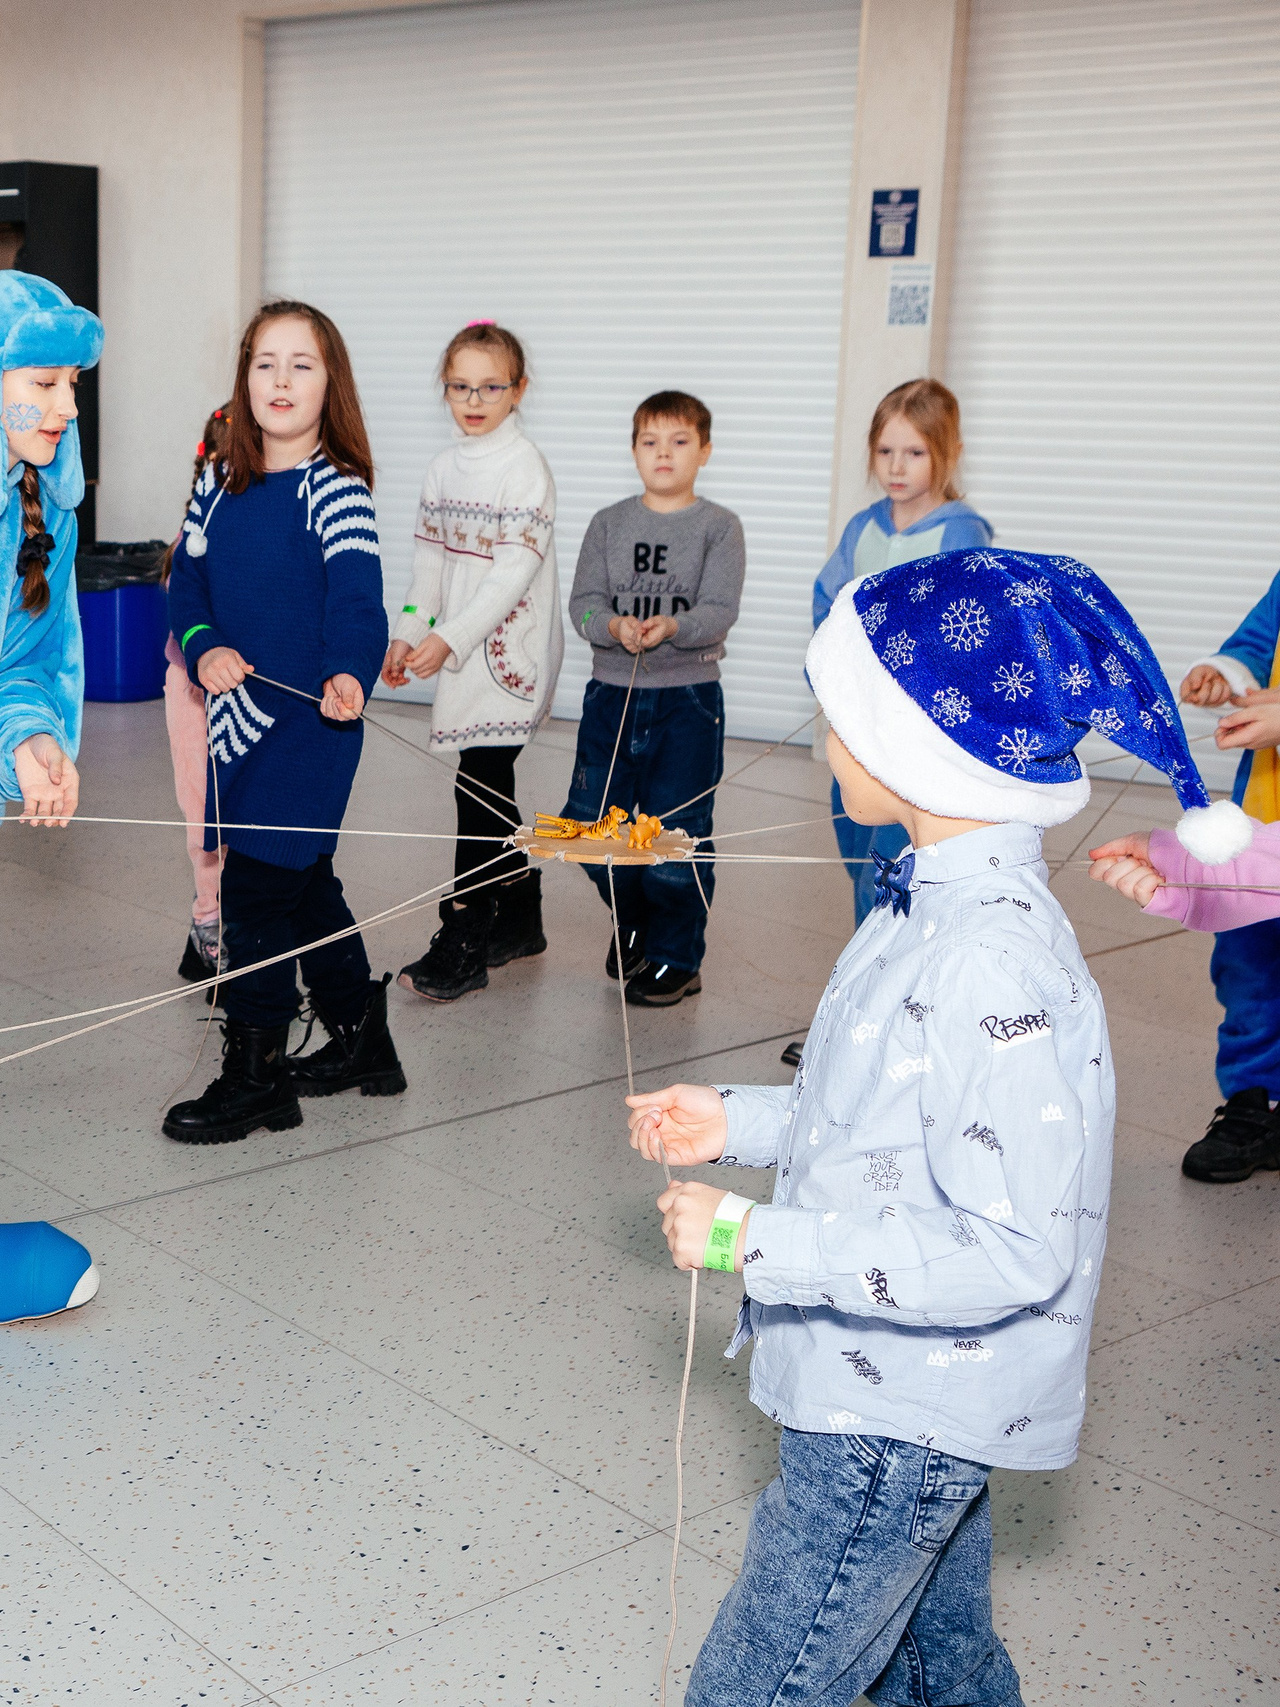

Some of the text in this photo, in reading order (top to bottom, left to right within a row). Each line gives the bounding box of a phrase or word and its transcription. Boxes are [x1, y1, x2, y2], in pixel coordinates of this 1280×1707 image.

[634, 542, 668, 574] BE
[869, 1160, 901, 1172] YOUR
[863, 1171, 904, 1184] CRAZY
[872, 1181, 899, 1192] IDEA
[953, 1339, 984, 1350] NEVER
